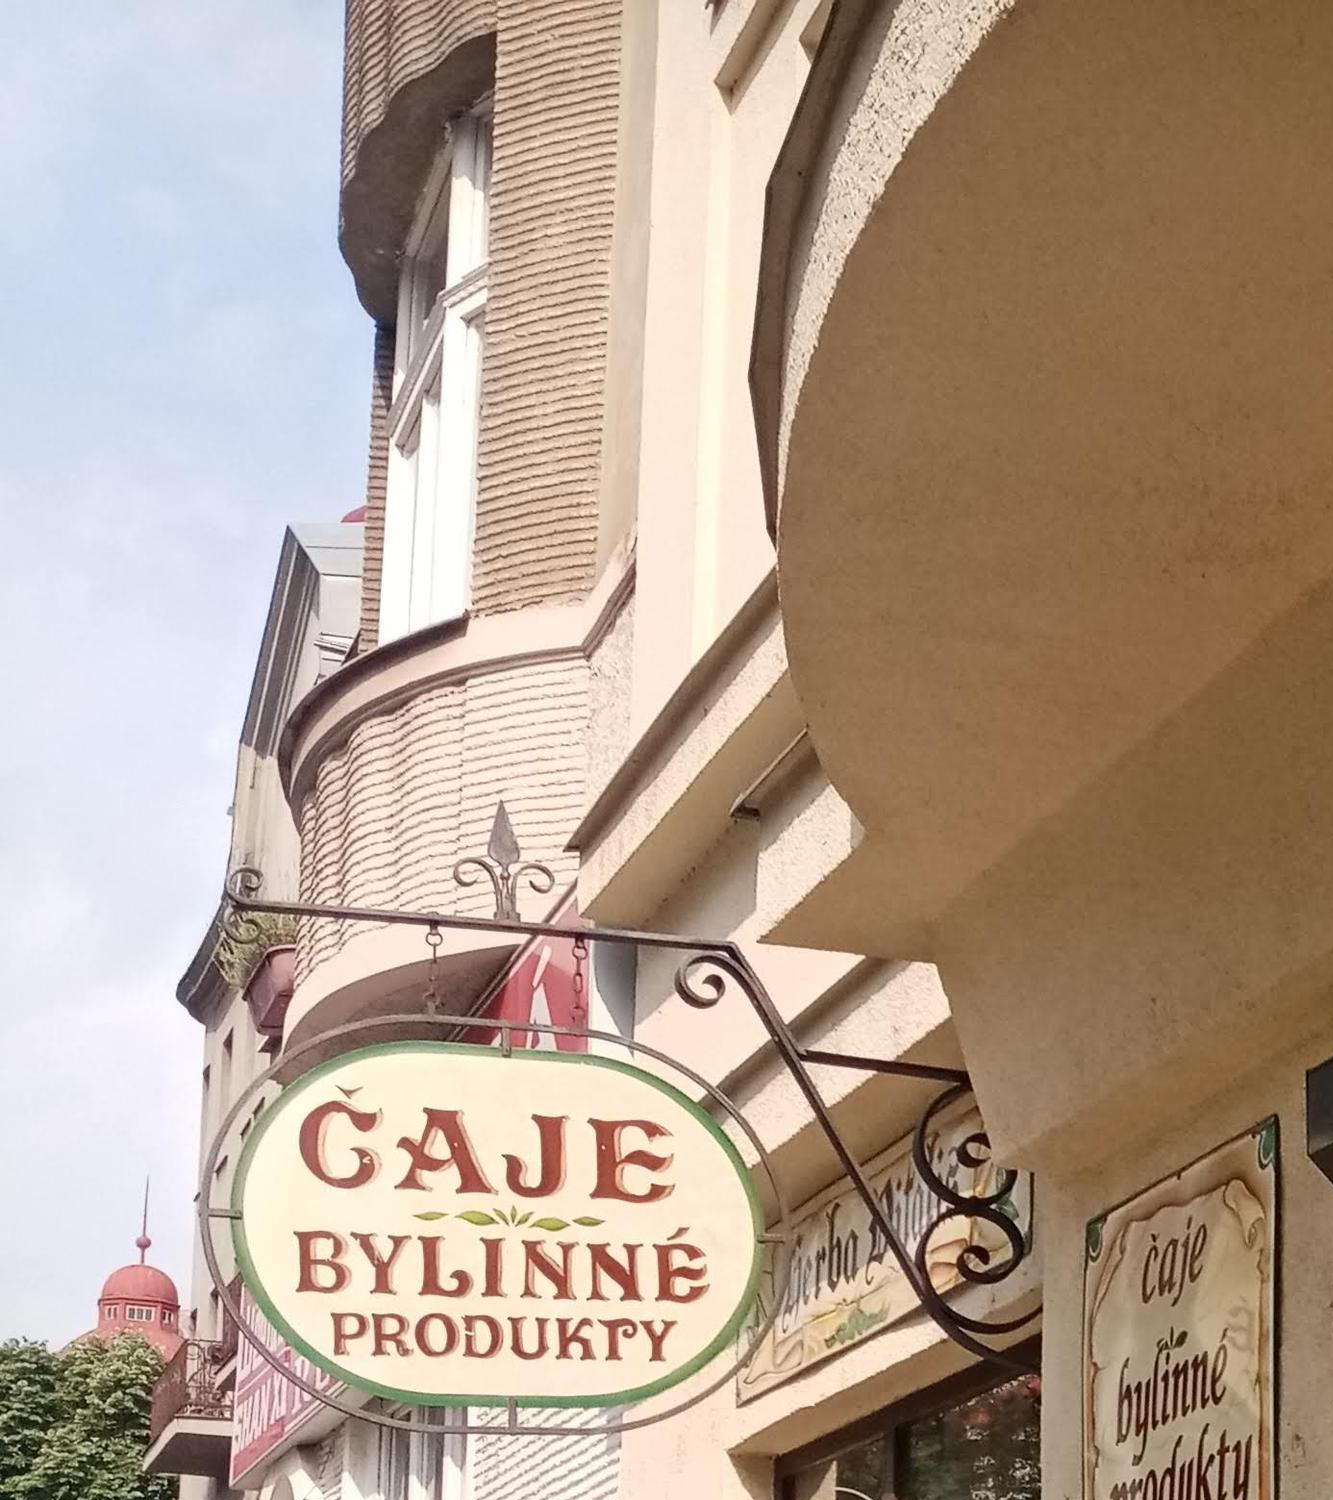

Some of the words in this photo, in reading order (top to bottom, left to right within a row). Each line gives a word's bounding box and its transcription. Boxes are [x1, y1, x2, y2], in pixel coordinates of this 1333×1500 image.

[299, 1084, 675, 1203] ČAJE
[294, 1227, 710, 1303] BYLINNÉ
[1142, 1216, 1206, 1307] čaje
[331, 1312, 677, 1362] PRODUKTY
[1116, 1328, 1228, 1466] bylinné
